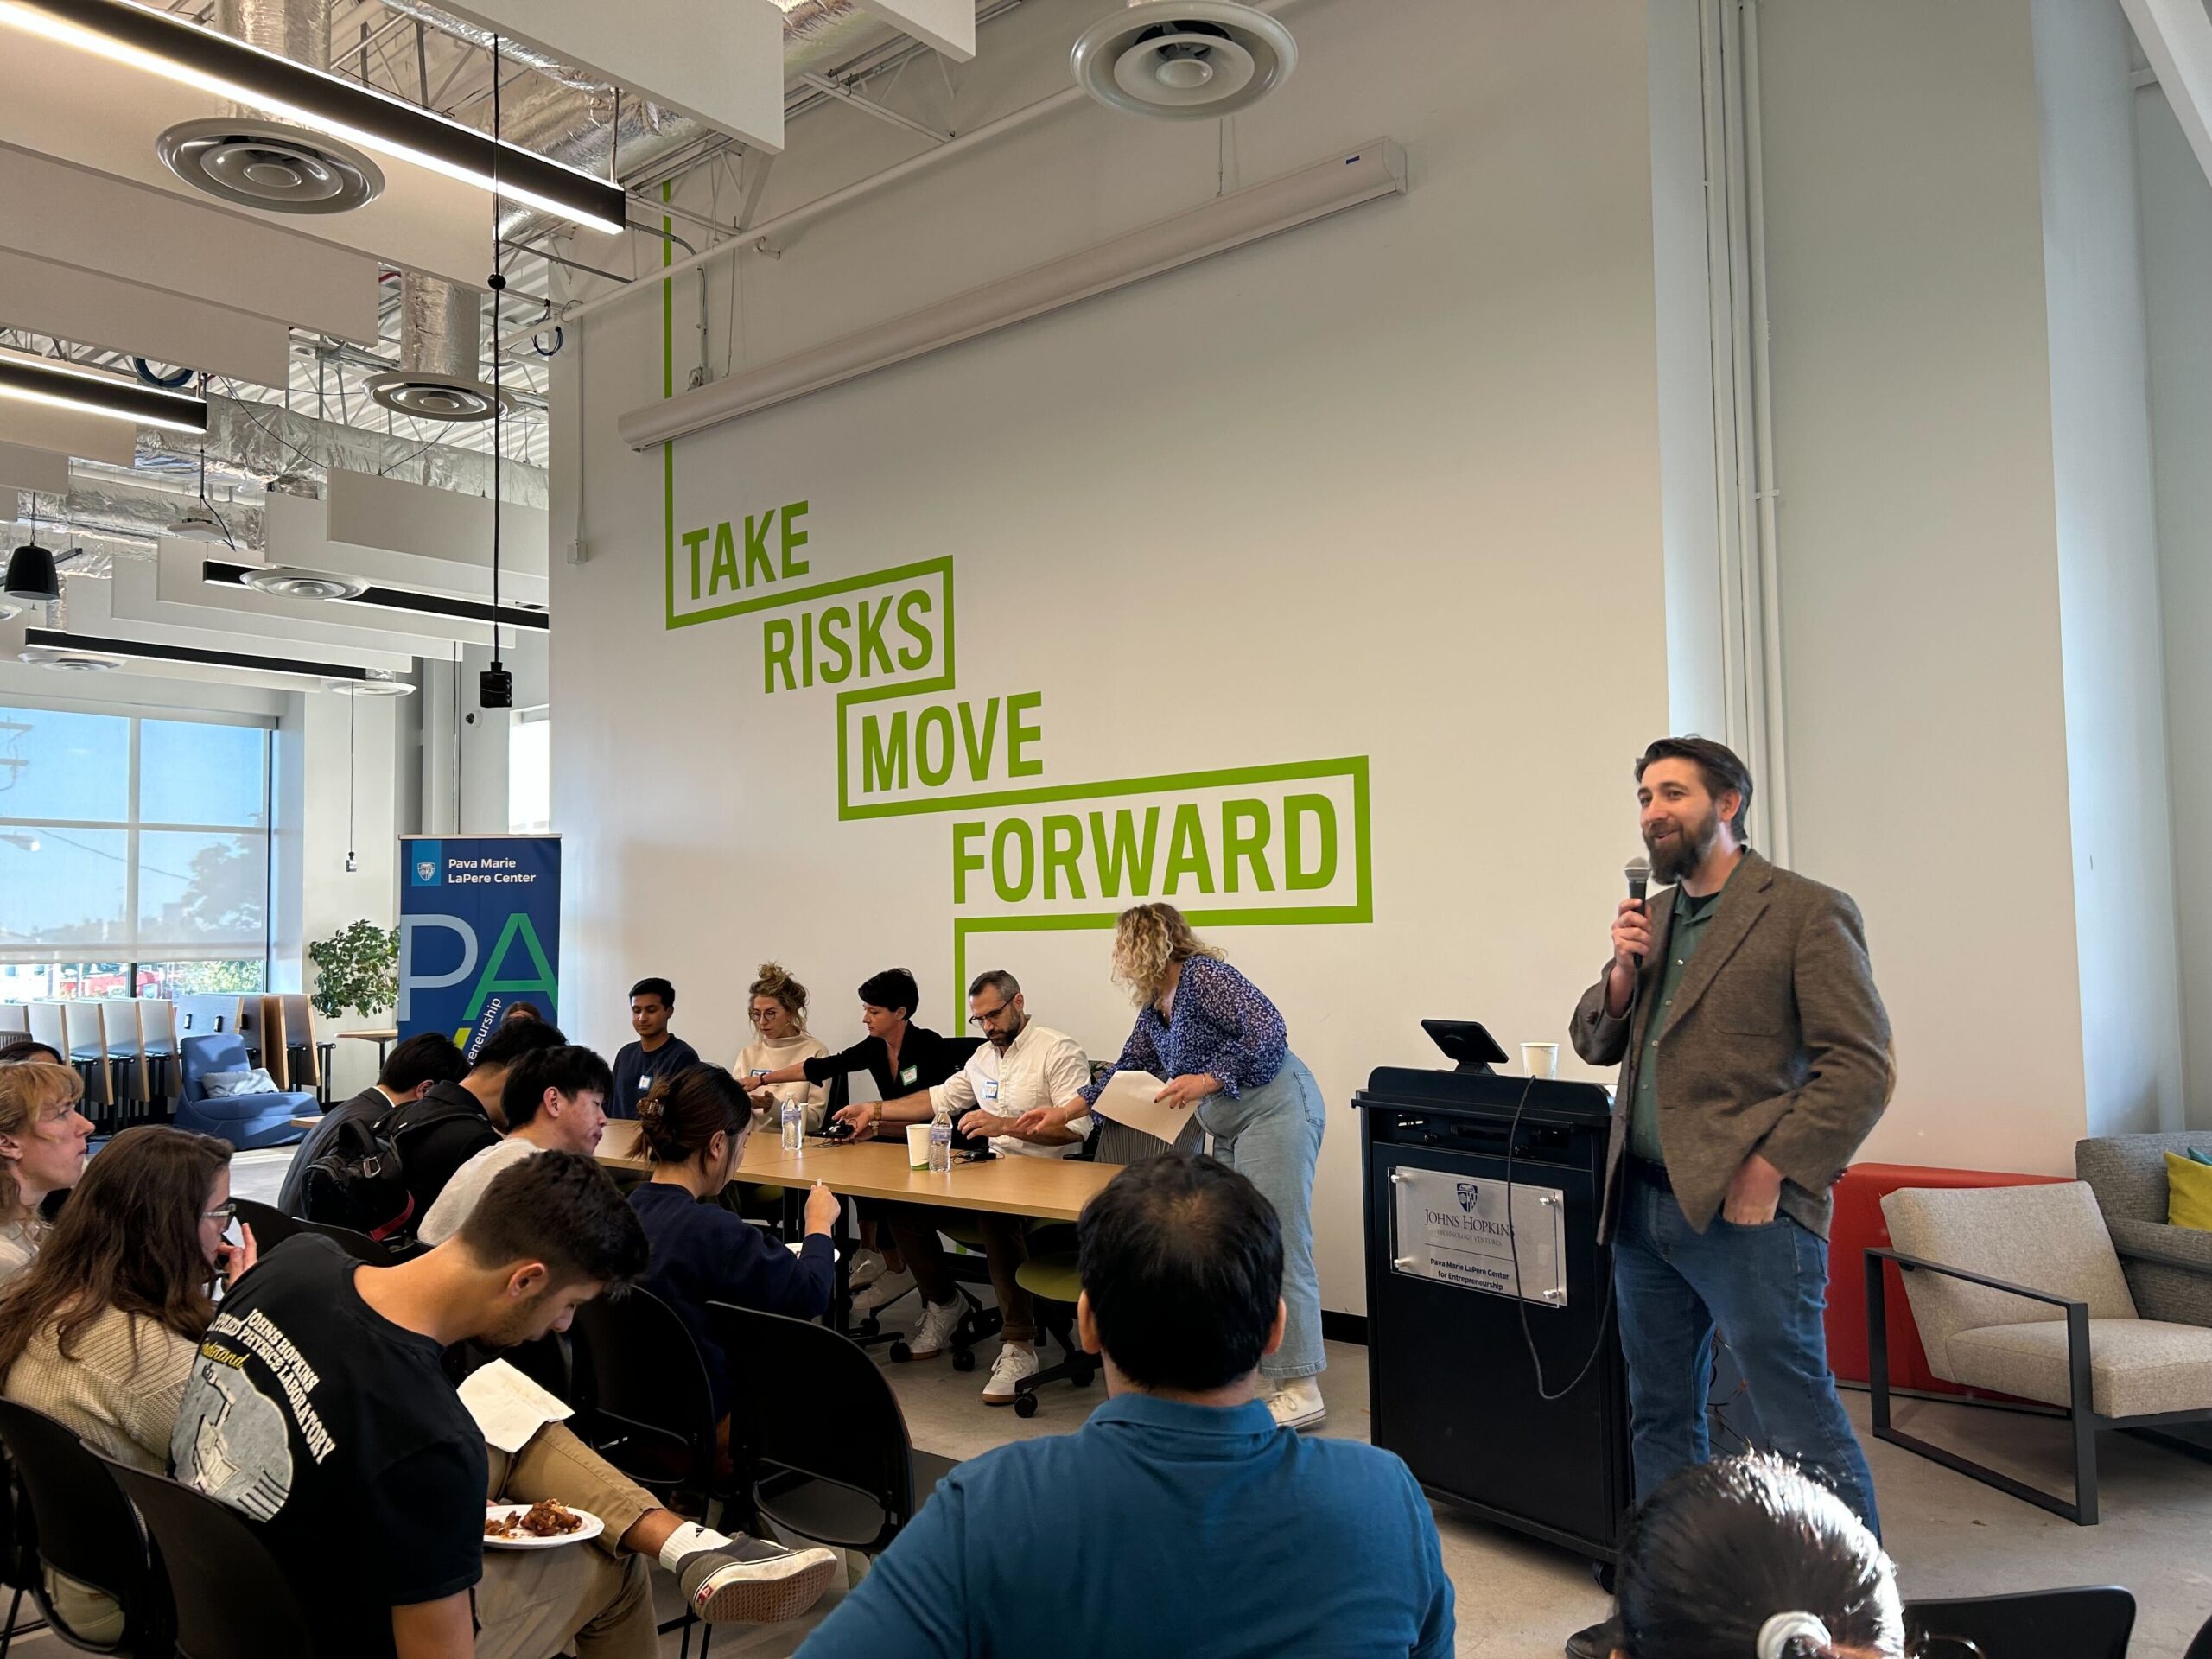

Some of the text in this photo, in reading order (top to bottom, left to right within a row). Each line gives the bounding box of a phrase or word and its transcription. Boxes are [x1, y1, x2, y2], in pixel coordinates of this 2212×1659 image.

[682, 501, 810, 600] TAKE
[764, 589, 933, 693] RISKS
[862, 691, 1044, 793] MOVE
[448, 857, 517, 868] Pava Marie
[448, 873, 536, 884] LaPere Center
[953, 793, 1338, 905] FORWARD
[1424, 1209, 1460, 1228] JOHNS
[1430, 1258, 1510, 1280] Pava Marie LaPere Center
[1448, 1272, 1503, 1291] Entrepreneurship
[241, 1308, 321, 1394] JOHNS HOPKINS
[236, 1325, 286, 1373] PHYSICS
[276, 1364, 337, 1465] LABORATORY
